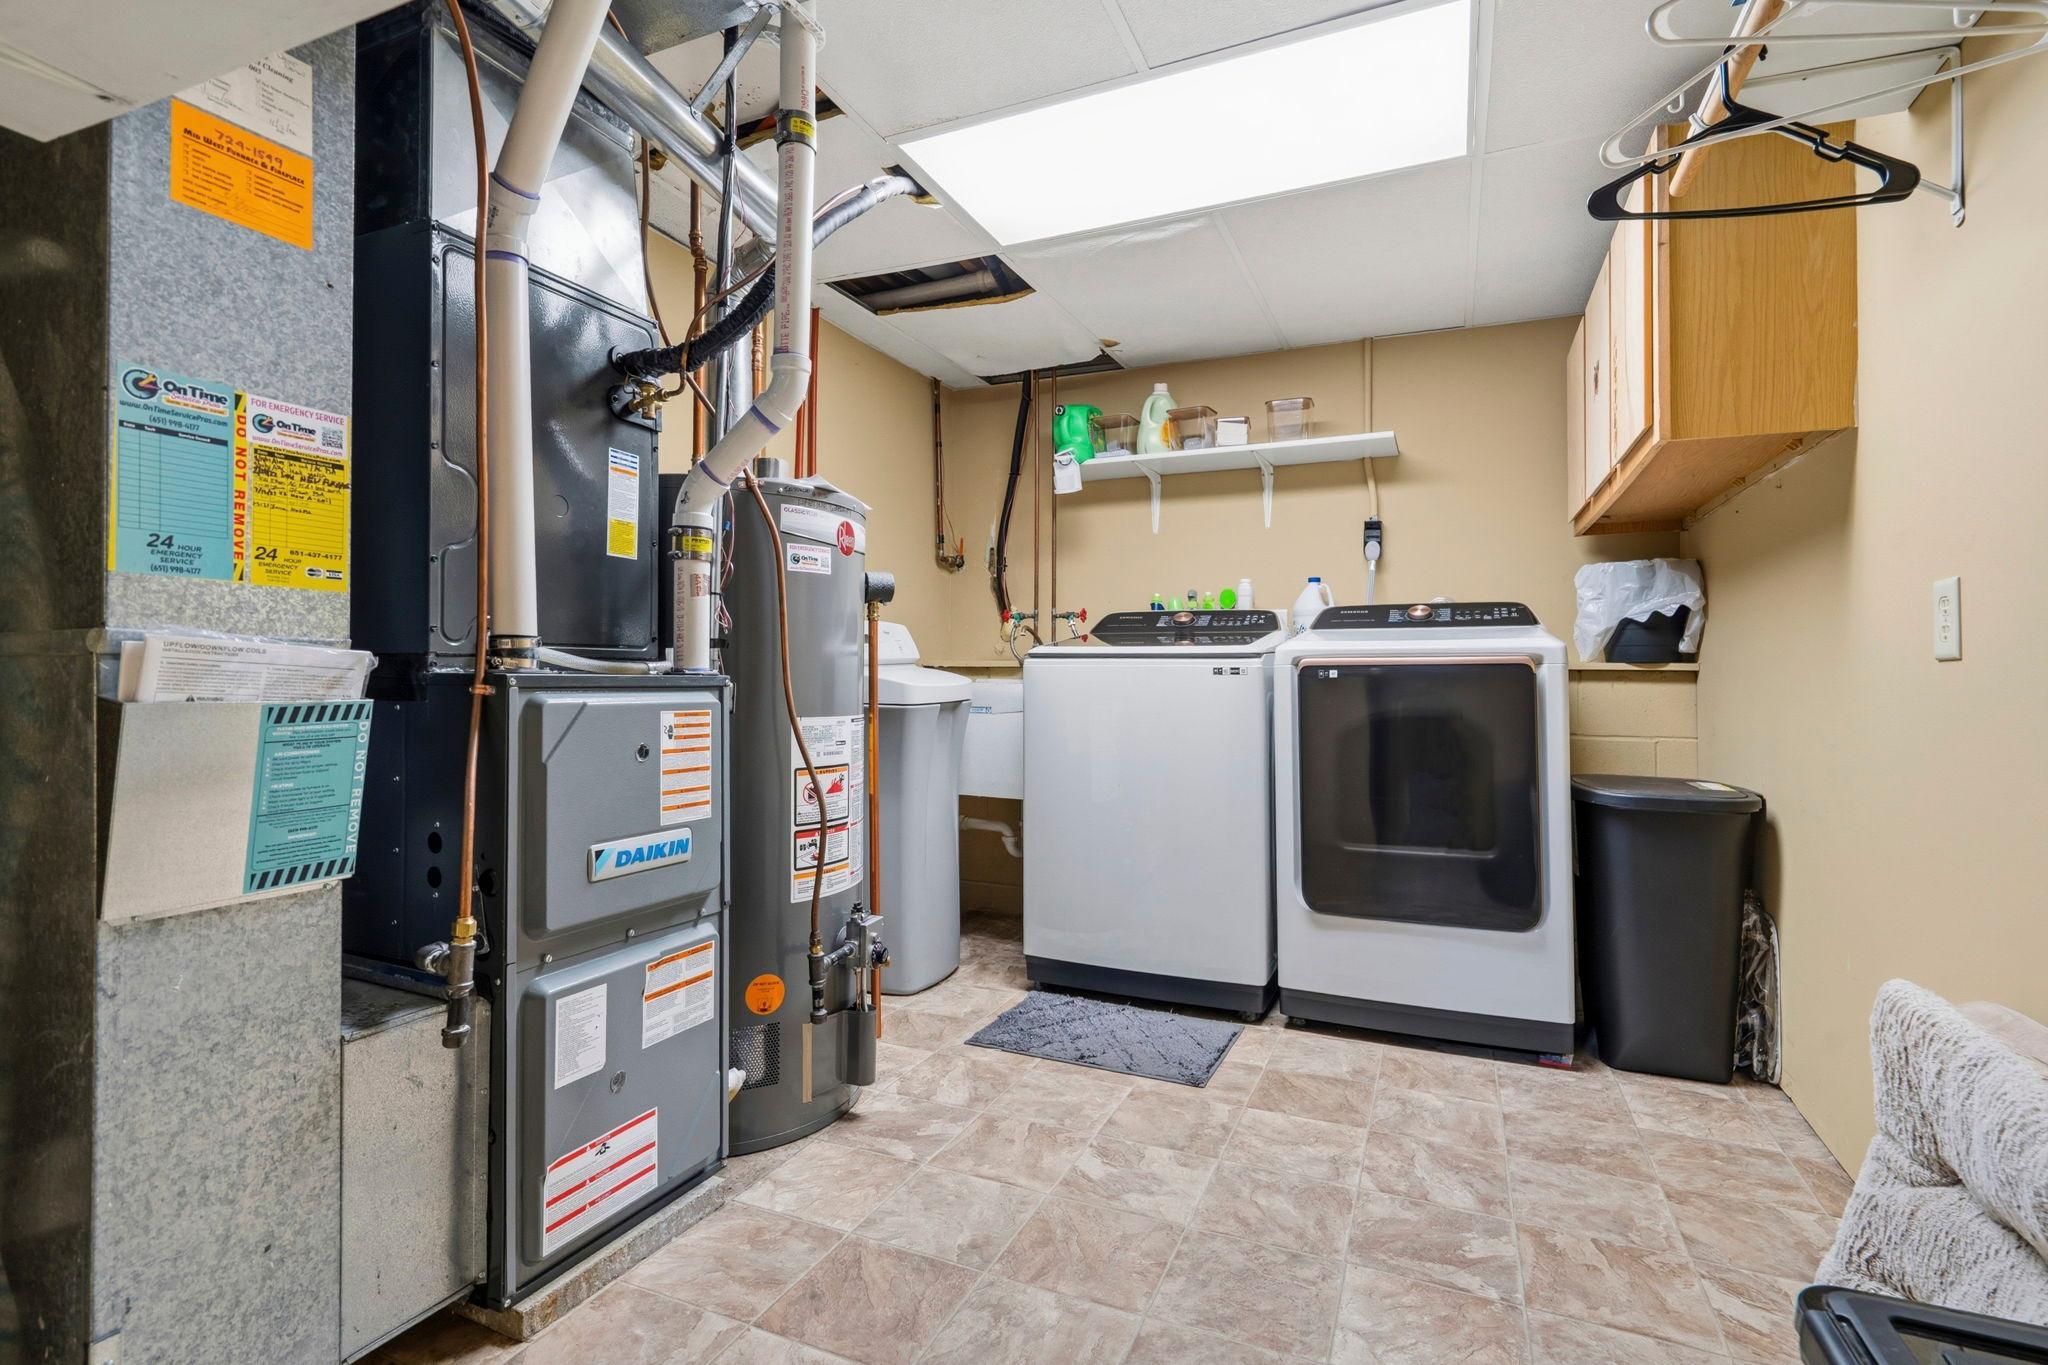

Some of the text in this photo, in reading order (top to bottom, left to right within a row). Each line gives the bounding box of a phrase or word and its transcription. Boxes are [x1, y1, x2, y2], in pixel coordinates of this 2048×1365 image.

[262, 63, 294, 84] Cleaning
[251, 398, 345, 426] FOR EMERGENCY SERVICE
[233, 414, 247, 560] DO NOT REMOVE
[146, 532, 202, 553] 24 HOUR
[150, 548, 203, 559] EMERGENCY
[160, 557, 194, 566] SERVICE
[254, 546, 278, 562] 24
[150, 564, 169, 574] (651)
[258, 561, 299, 570] EMERGENCY
[264, 568, 292, 576] SERVICE
[345, 721, 369, 853] DO NOT REMOVE
[615, 837, 690, 868] DAIKIN
